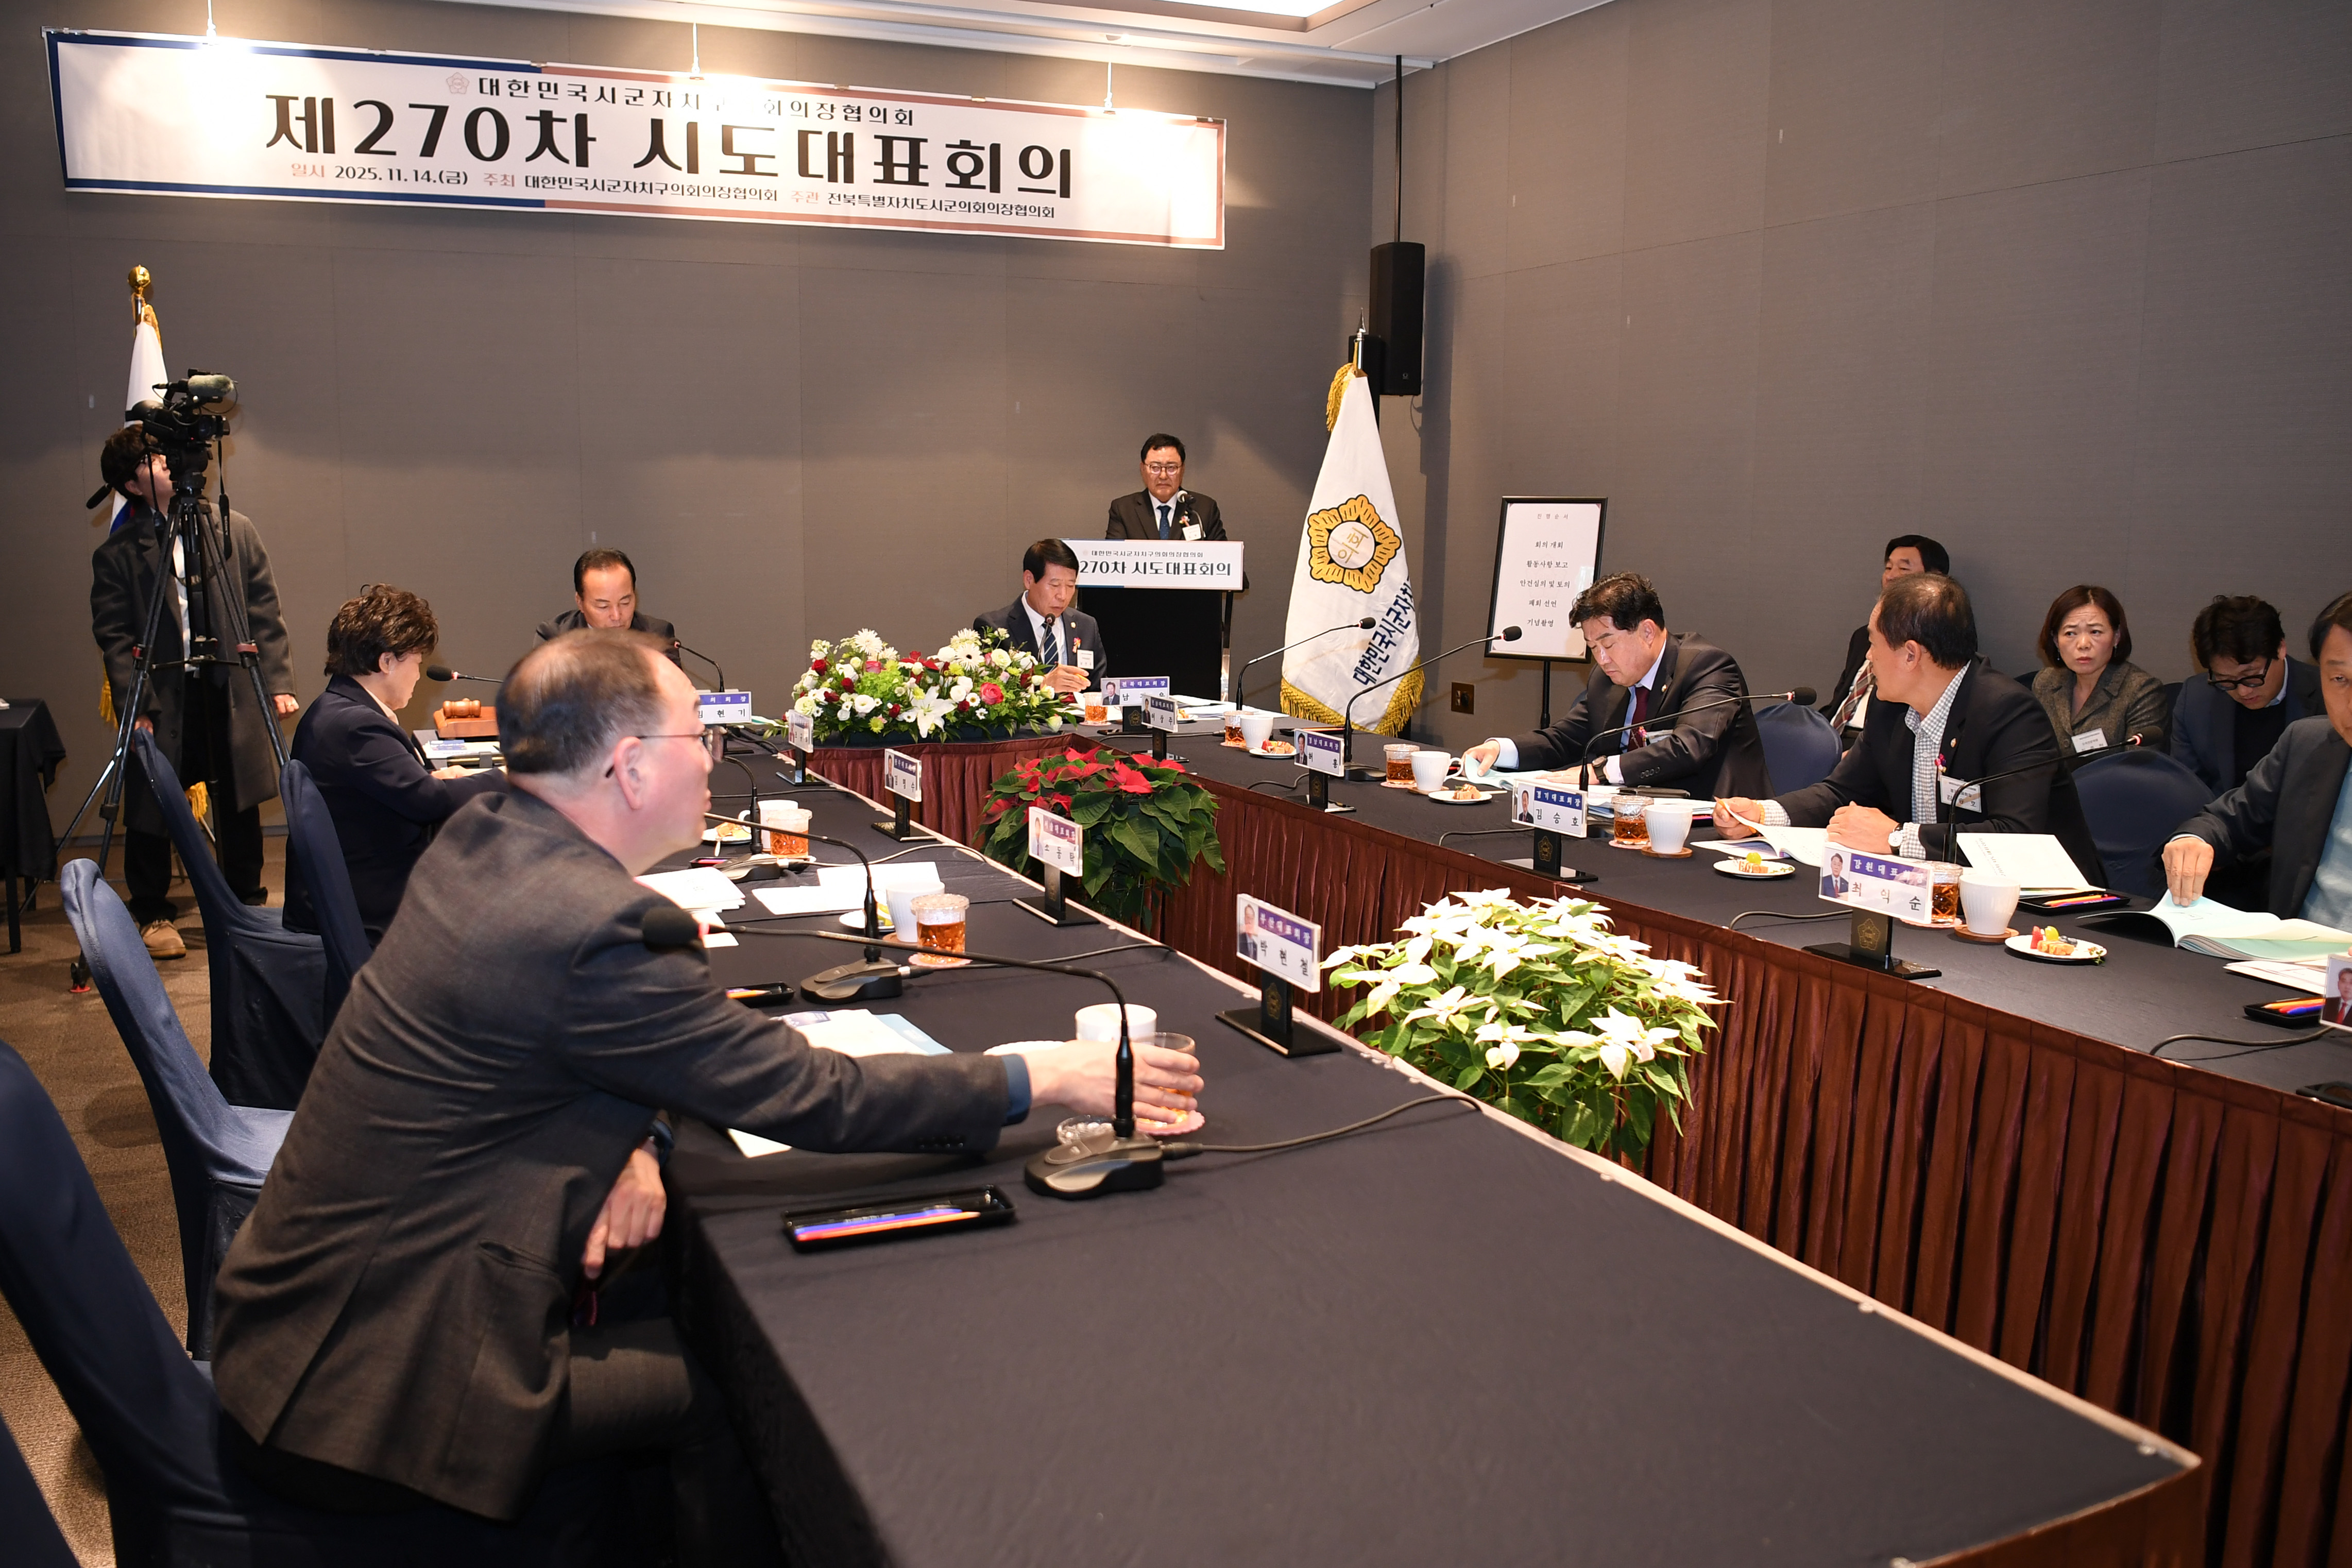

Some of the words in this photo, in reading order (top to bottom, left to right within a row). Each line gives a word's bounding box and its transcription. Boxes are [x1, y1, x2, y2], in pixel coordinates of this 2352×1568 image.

[479, 77, 914, 126] 대한민국시군자치회의장협의회
[265, 94, 597, 168] 제270차
[633, 117, 1071, 199] 시도대표회의
[291, 163, 325, 178] 일시
[483, 173, 515, 188] 주최
[524, 175, 777, 201] 대한민국시군자치구의회의장협의회
[791, 190, 819, 204] 주관
[828, 192, 1055, 219] 전북특별자치도시군의회의장협의회
[1535, 540, 1548, 549] 회의
[1550, 541, 1563, 549] 개회
[1131, 561, 1231, 576] 시도대표회의
[1526, 560, 1553, 569] 활동사항
[1520, 580, 1546, 588] 안건심의
[1548, 580, 1554, 588] 및
[1556, 581, 1570, 589] 토의
[1544, 600, 1557, 608] 선언
[1527, 619, 1554, 627] 기념촬영
[1308, 737, 1339, 751] 경남대표회장
[1536, 790, 1581, 807] 경기대표회장
[1536, 808, 1579, 827] 김승호
[1853, 859, 1924, 884] 강원대표회장
[1851, 881, 1922, 911] 최익순
[1259, 912, 1310, 945] 부산대표회장
